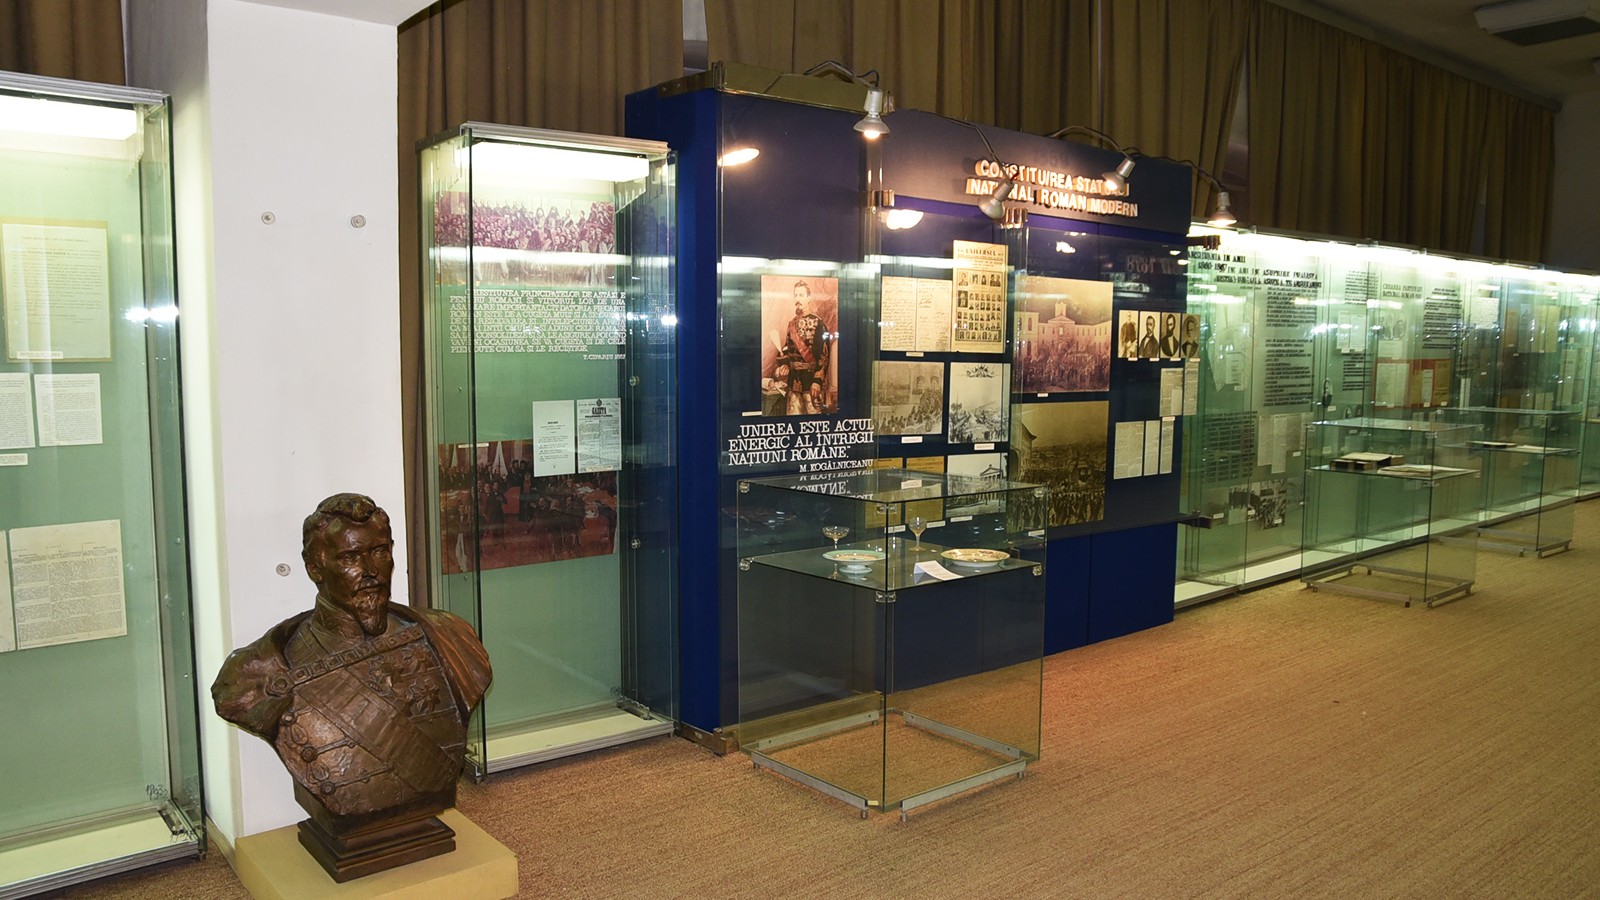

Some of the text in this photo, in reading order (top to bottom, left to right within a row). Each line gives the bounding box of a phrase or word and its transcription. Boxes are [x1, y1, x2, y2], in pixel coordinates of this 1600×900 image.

[1040, 188, 1087, 211] ROMAN
[1088, 197, 1138, 217] MODERN
[799, 420, 830, 434] ESTE
[834, 418, 874, 432] ACTUL
[728, 435, 790, 452] ENERGIC
[794, 435, 813, 448] AL
